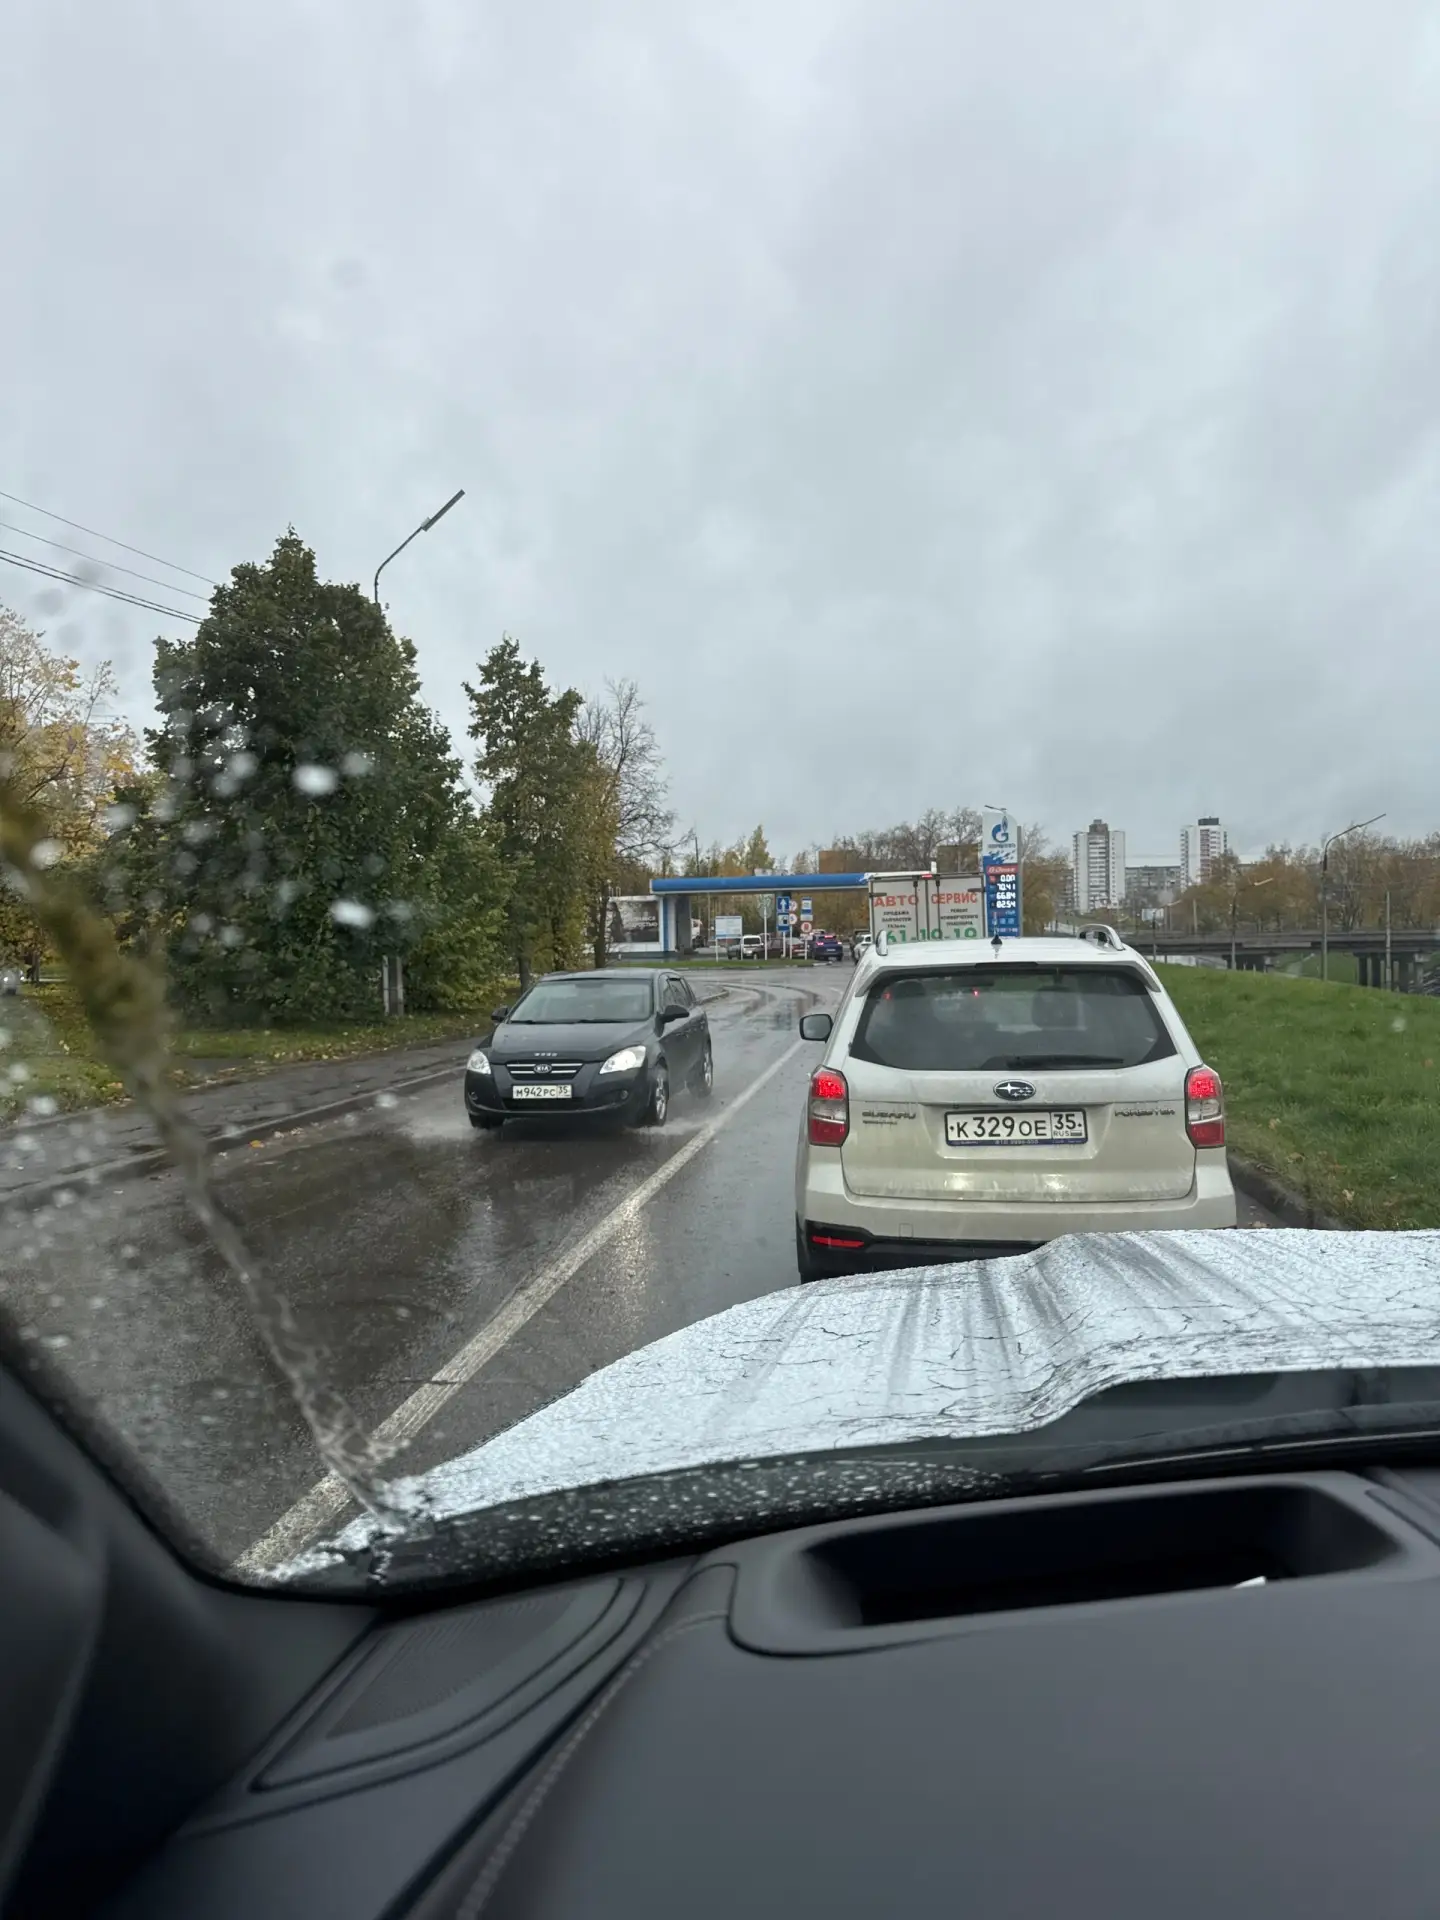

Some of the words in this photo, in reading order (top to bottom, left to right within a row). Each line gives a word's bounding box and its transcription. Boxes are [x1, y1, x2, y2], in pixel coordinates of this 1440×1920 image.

[874, 895, 919, 907] АВТО
[931, 892, 977, 904] СЕРВИС
[516, 1087, 556, 1097] М942РС
[558, 1085, 569, 1094] 35
[1053, 1113, 1077, 1130] 35
